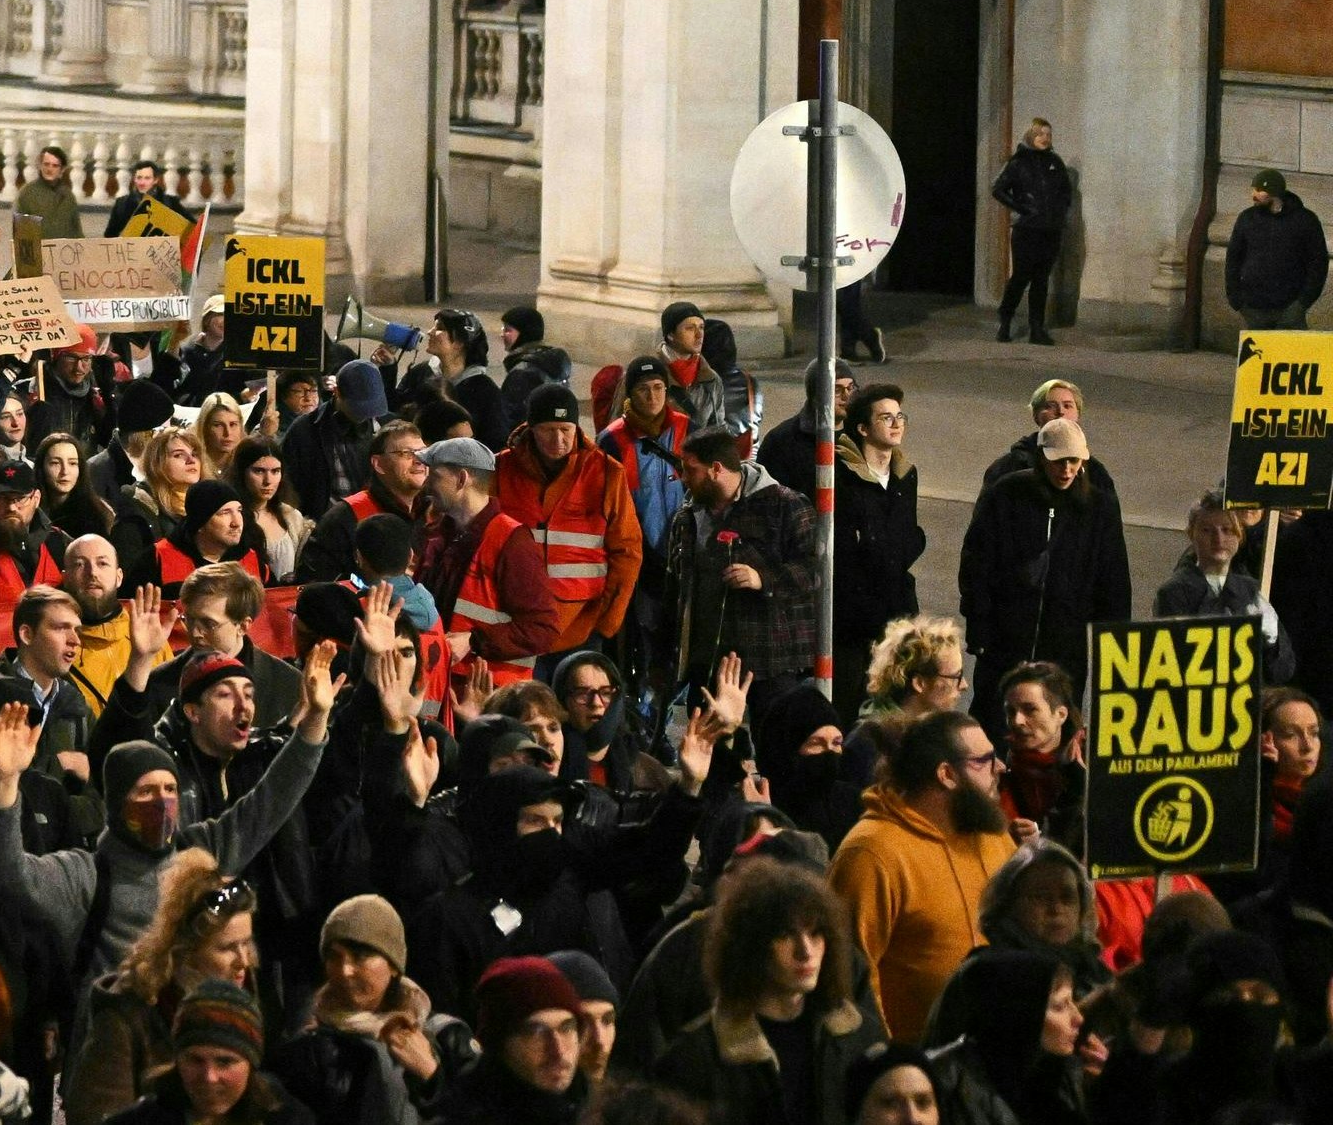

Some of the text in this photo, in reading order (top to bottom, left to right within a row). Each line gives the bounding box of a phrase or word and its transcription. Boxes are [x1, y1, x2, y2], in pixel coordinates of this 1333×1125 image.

[43, 242, 138, 271] TOP THE
[44, 268, 154, 291] ENOCIDE
[247, 258, 305, 284] ICKL
[72, 298, 189, 320] TAKE RESPONSIBILITY
[234, 292, 312, 317] IST EIN
[47, 328, 68, 341] DA!
[250, 325, 297, 352] AZI
[1259, 362, 1324, 396] ICKL
[1241, 407, 1328, 438] IST EIN
[1255, 452, 1309, 486] AZI
[1099, 622, 1255, 692] NAZIS
[1096, 684, 1254, 758] RAUS
[1109, 752, 1240, 774] AUS DEM PARLAMENT
